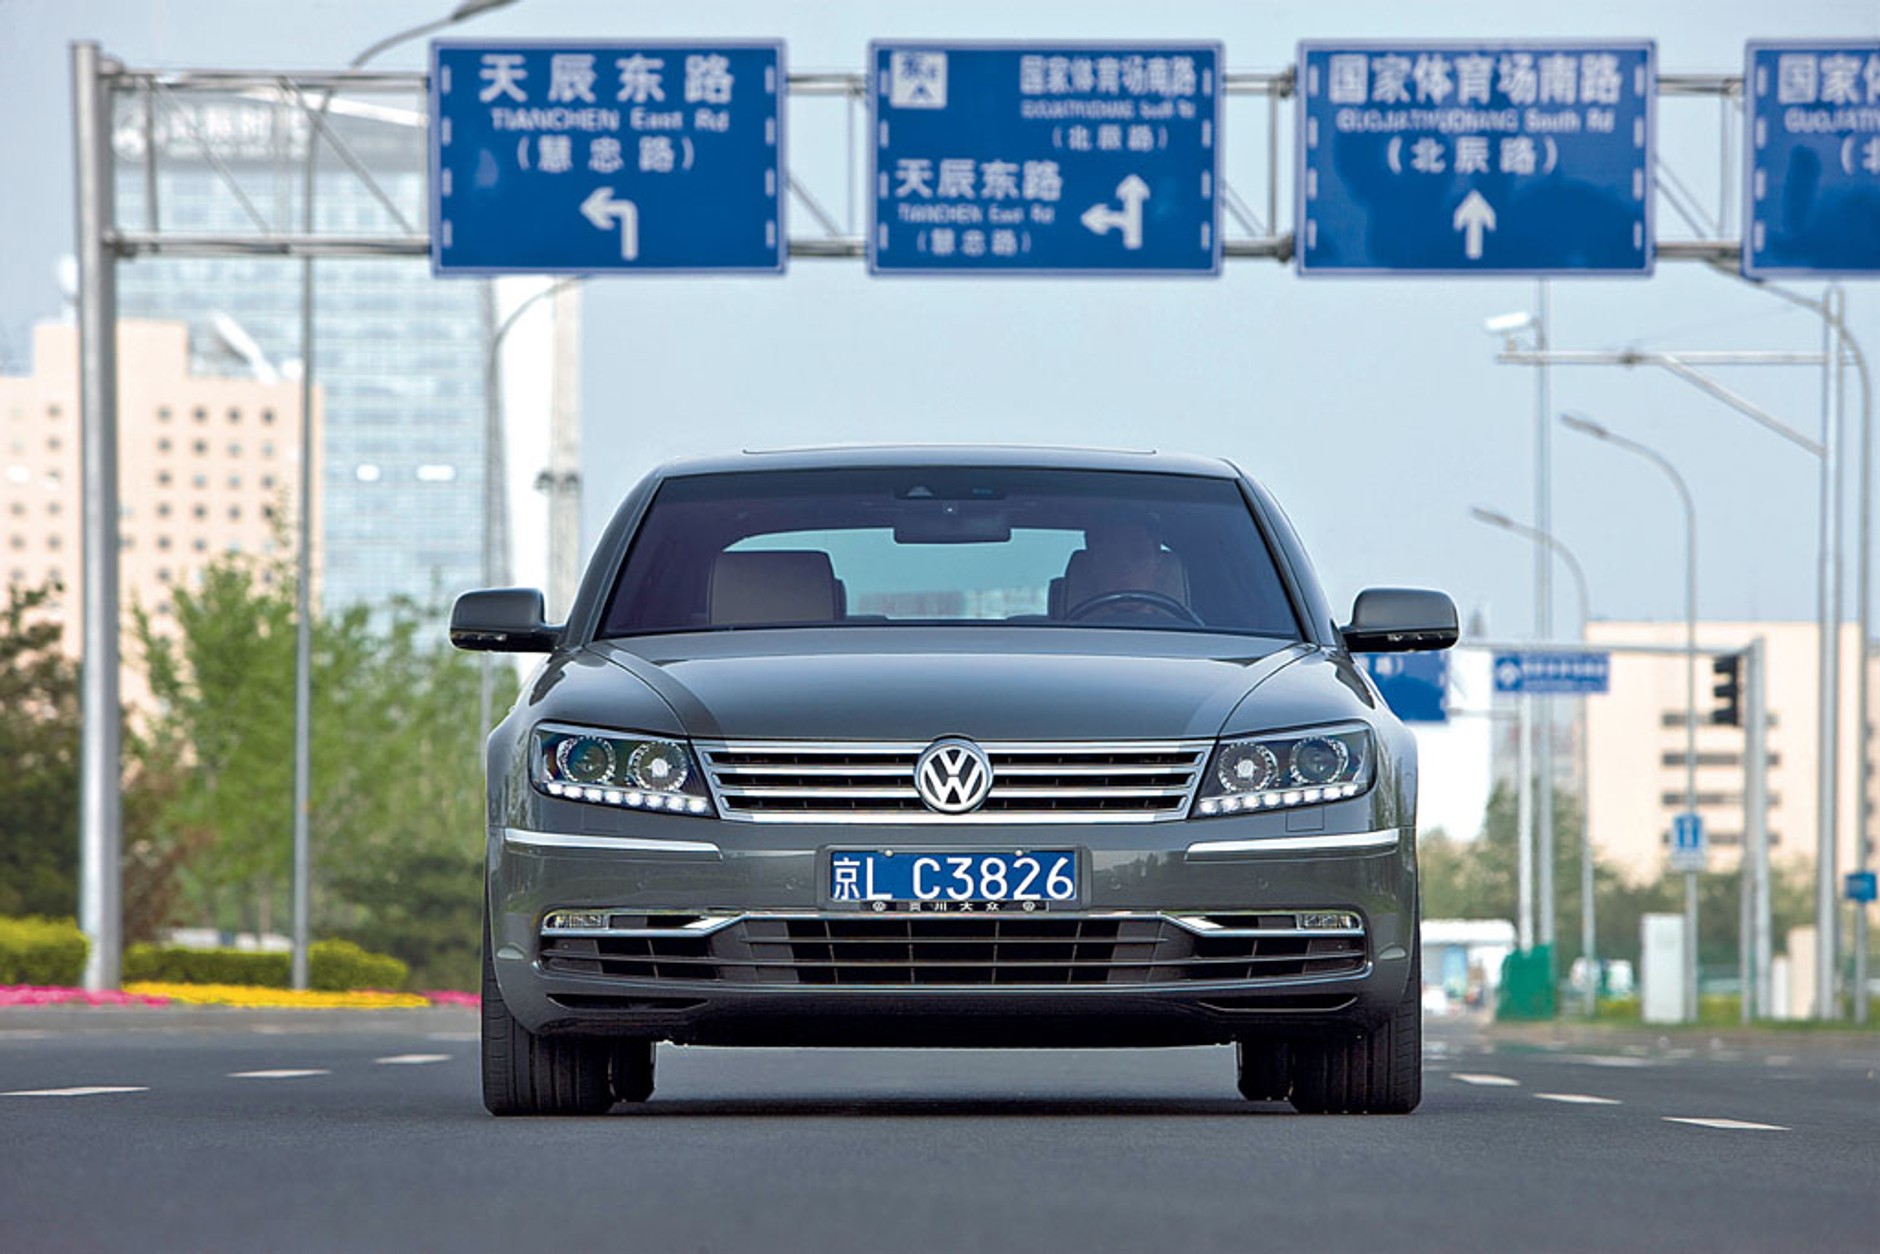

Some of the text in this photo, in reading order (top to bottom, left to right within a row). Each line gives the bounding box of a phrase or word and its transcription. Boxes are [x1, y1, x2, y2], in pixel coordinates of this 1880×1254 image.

[478, 54, 735, 103] 天辰东路
[1328, 53, 1622, 104] 国家体育场南路
[491, 107, 730, 132] TIANCHEN East Rd
[895, 158, 1063, 201] 天辰东路
